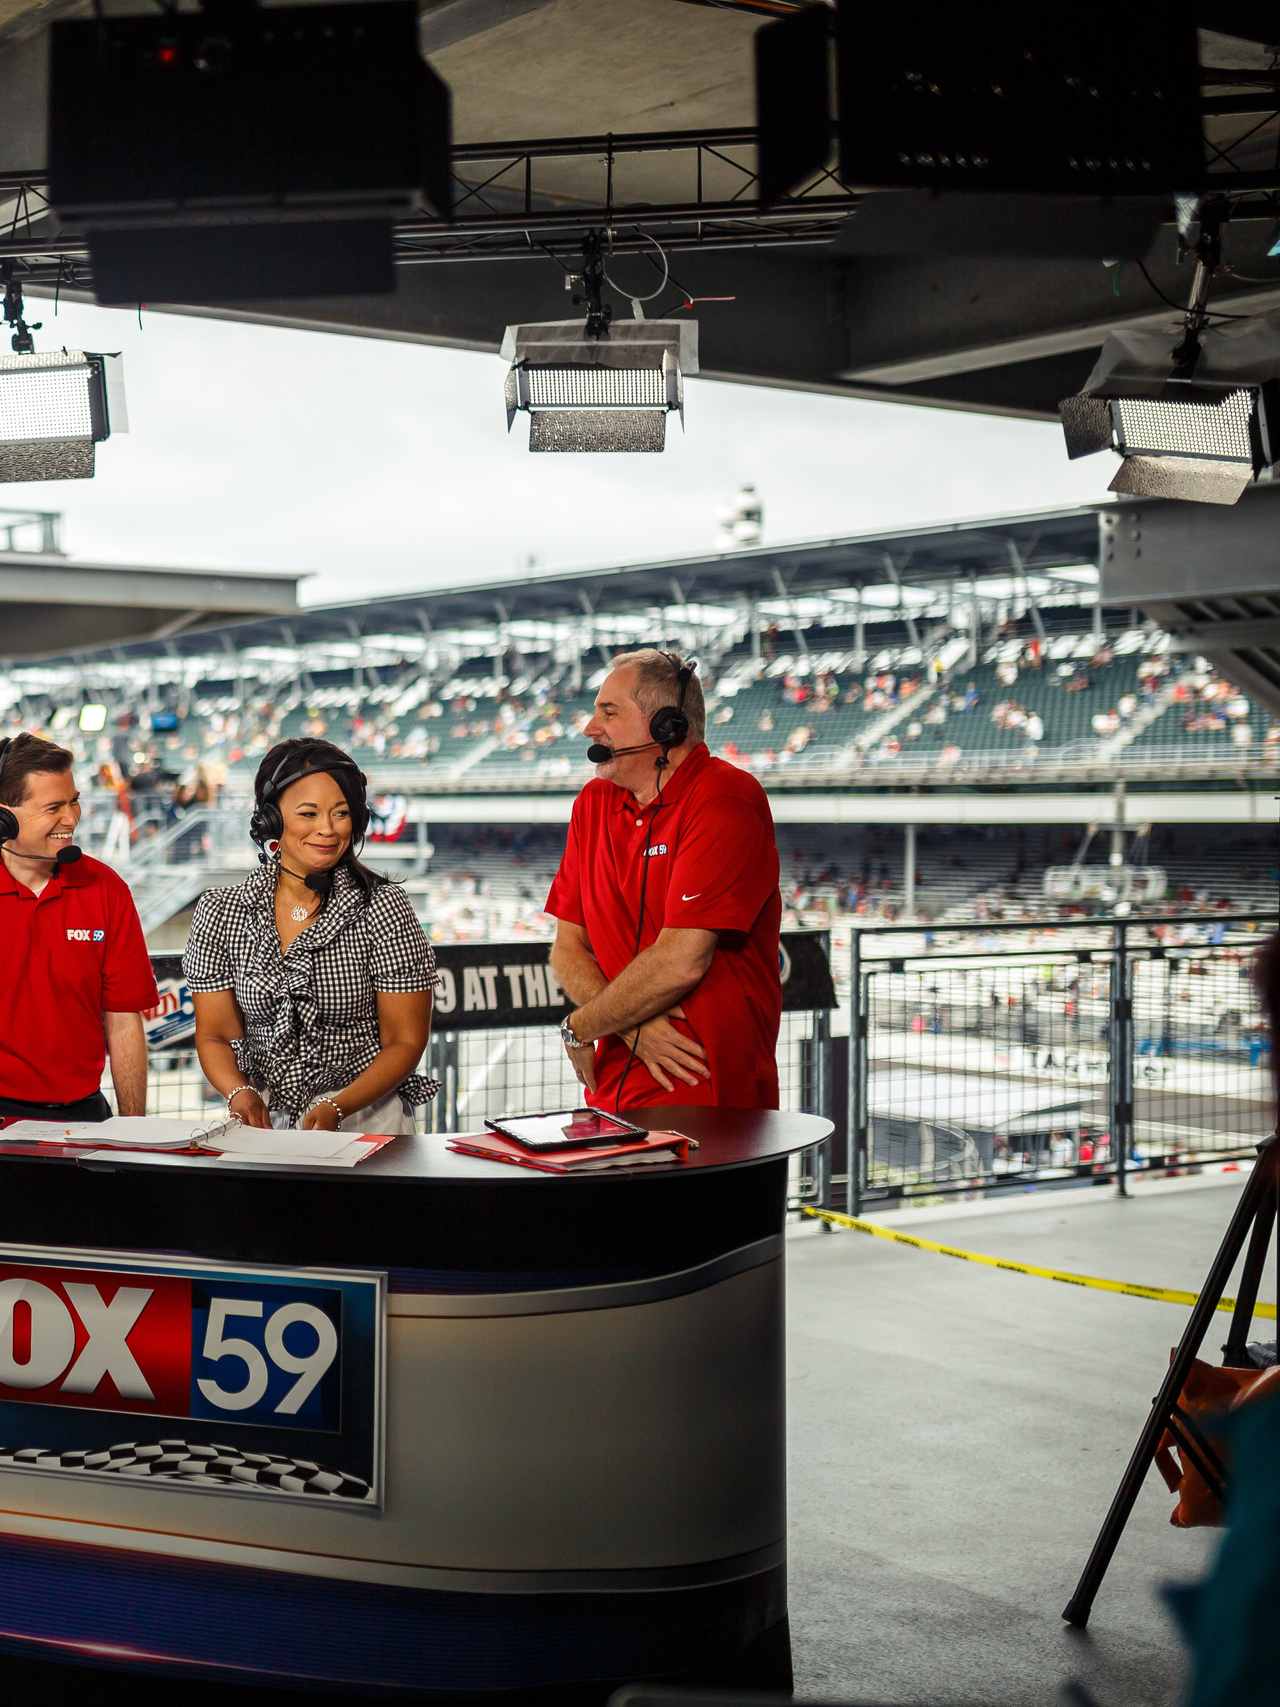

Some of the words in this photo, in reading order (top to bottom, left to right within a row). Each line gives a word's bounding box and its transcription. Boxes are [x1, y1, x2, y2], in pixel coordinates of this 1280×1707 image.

[659, 844, 667, 855] 59
[67, 929, 91, 941] FOX
[93, 930, 104, 941] 59
[463, 966, 498, 1011] AT
[503, 964, 565, 1008] THE
[197, 1297, 338, 1415] 59
